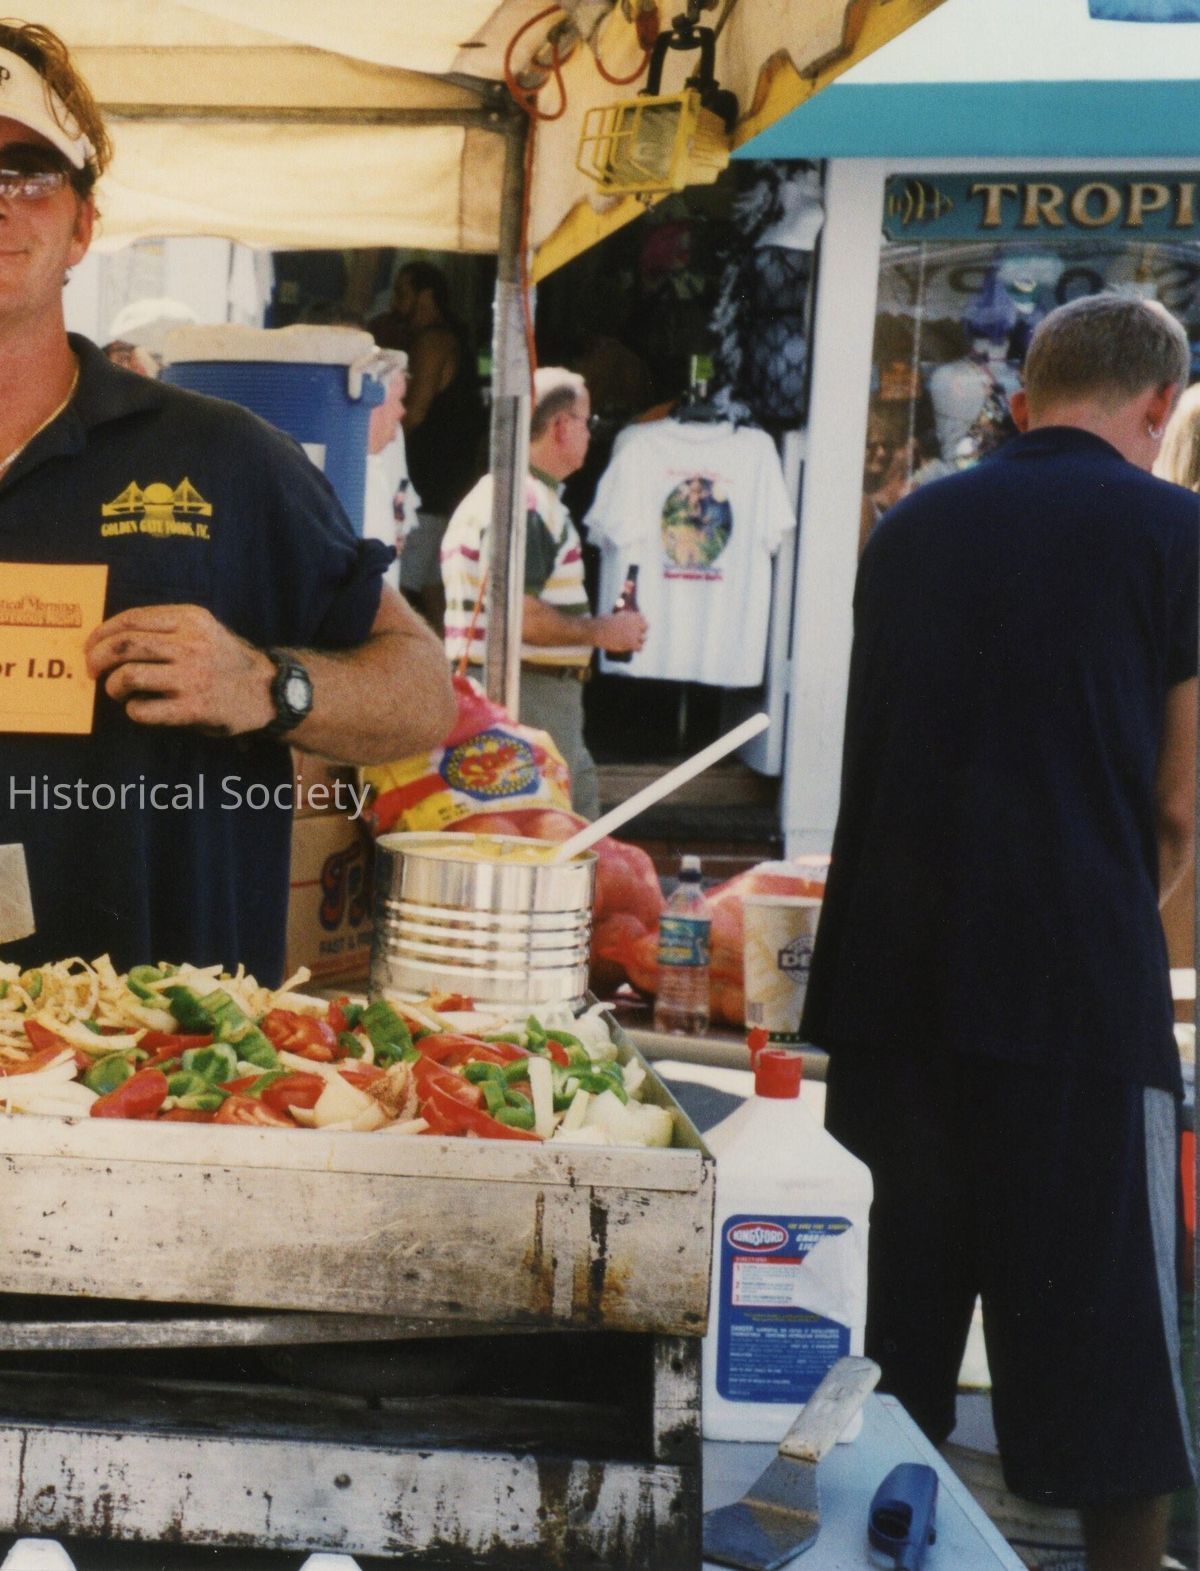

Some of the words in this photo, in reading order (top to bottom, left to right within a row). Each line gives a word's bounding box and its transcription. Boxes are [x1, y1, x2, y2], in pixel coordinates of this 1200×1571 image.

[971, 183, 1200, 228] TROPI
[27, 658, 73, 680] I.D.
[732, 1226, 784, 1247] KINGSFORD
